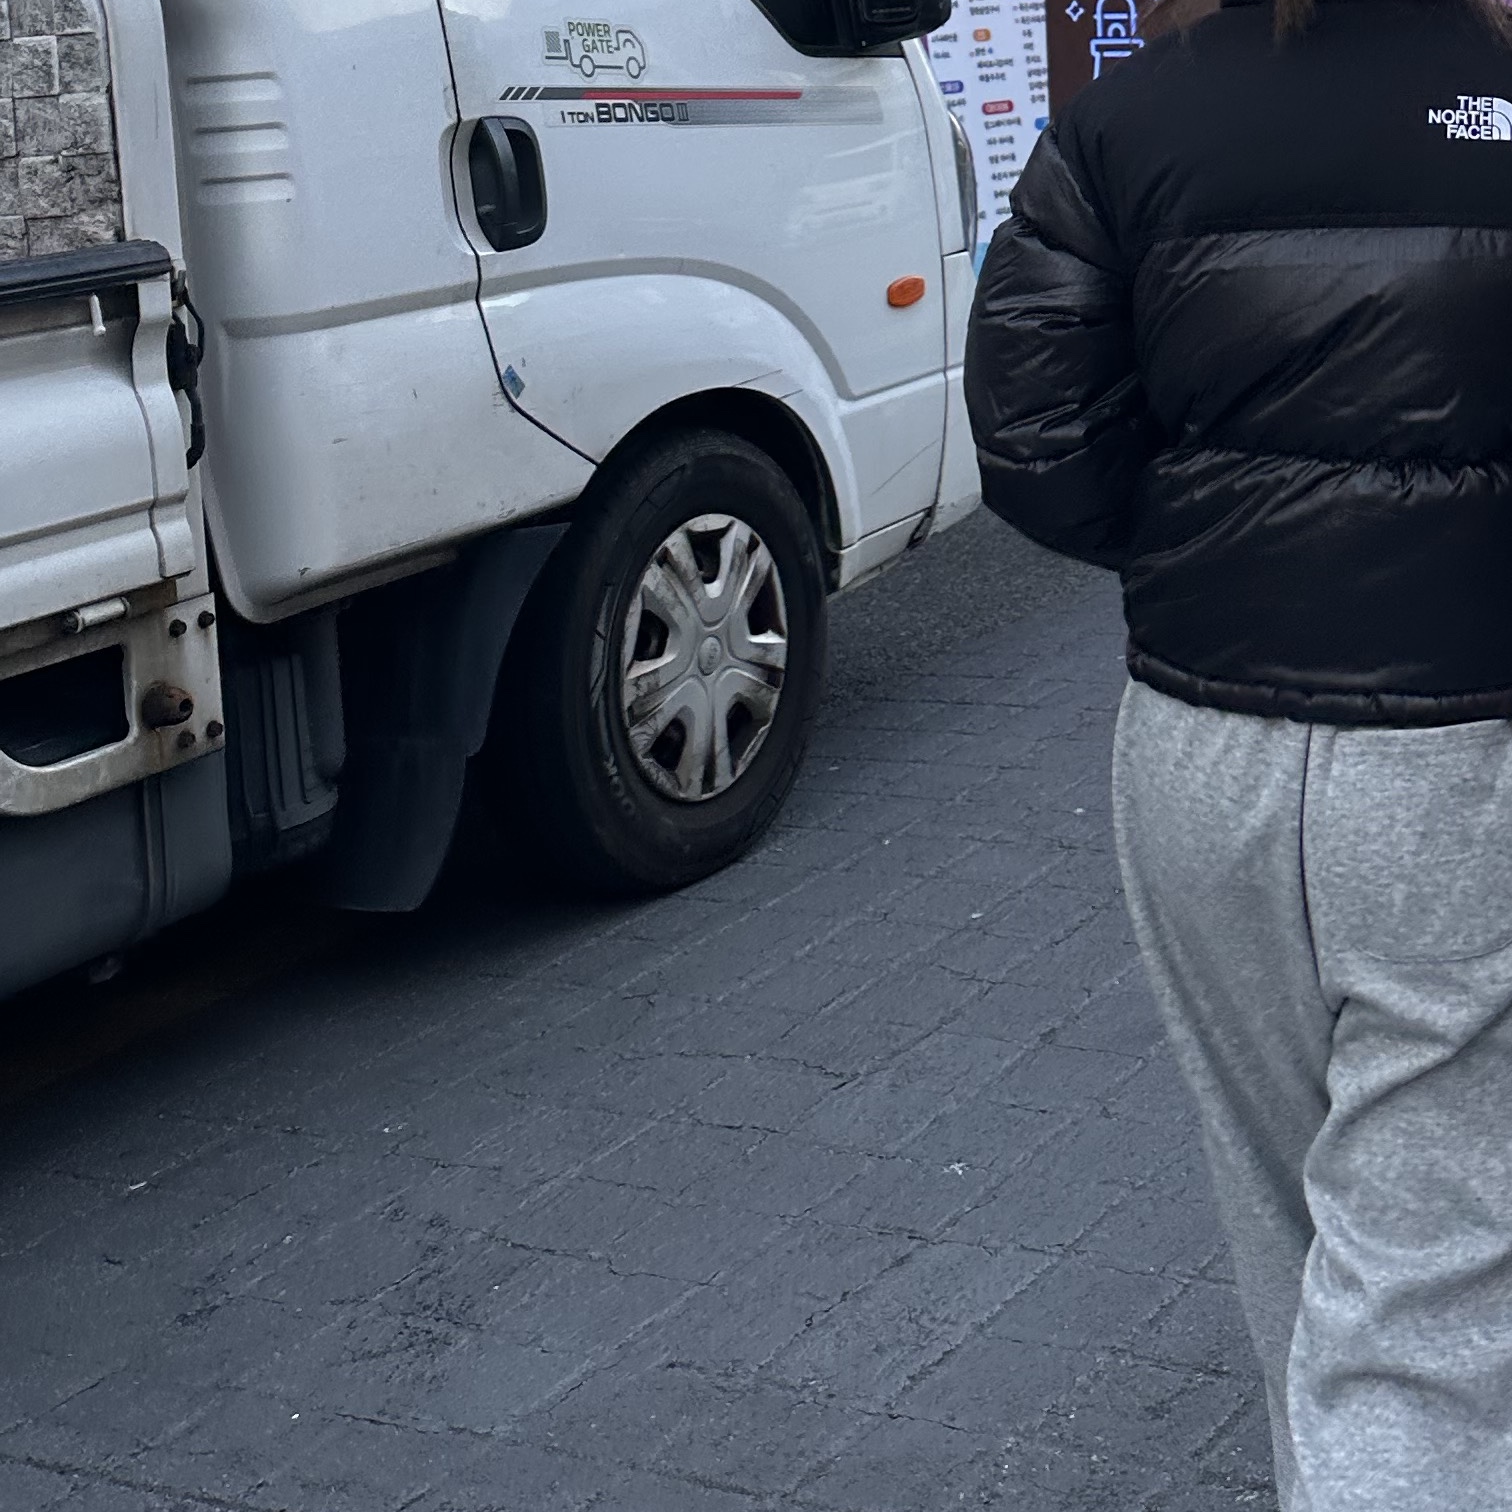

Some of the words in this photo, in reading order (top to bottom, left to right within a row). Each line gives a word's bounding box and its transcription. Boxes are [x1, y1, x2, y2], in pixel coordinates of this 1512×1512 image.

[568, 21, 611, 37] POWER
[582, 38, 614, 53] GATE
[1457, 95, 1493, 111] THE
[570, 110, 595, 124] TON
[595, 102, 676, 124] BONGO
[1428, 109, 1493, 125] NORTH
[1446, 124, 1493, 140] FACE
